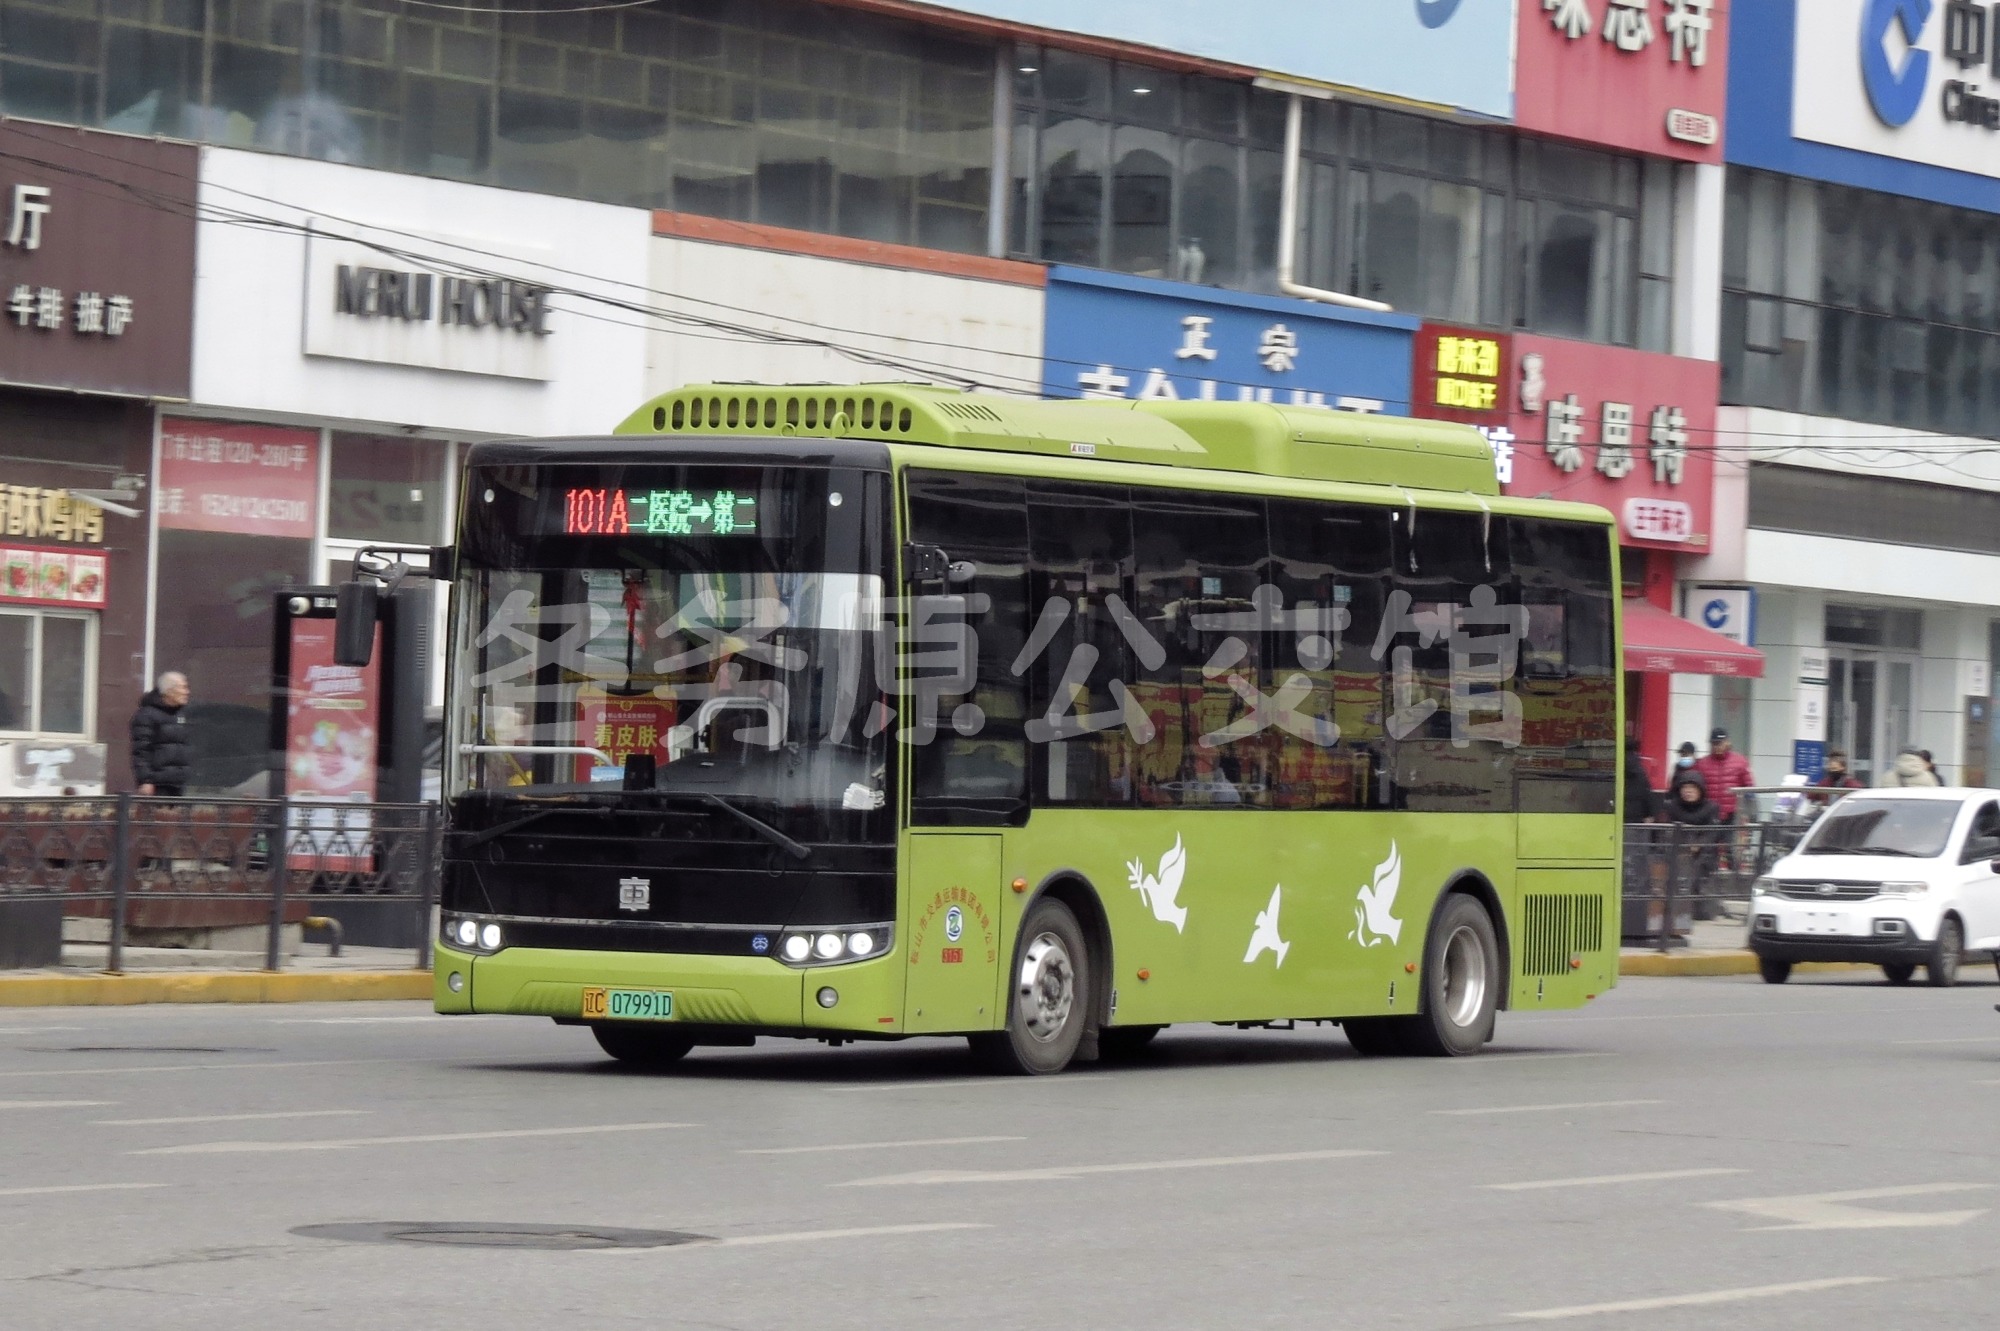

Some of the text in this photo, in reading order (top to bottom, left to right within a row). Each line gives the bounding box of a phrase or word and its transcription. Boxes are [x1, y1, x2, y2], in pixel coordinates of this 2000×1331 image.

[1944, 0, 2000, 80] 中
[8, 184, 52, 249] 厅
[8, 284, 134, 335] 牛排 披萨
[437, 276, 555, 338] HOUSE
[1174, 315, 1299, 372] 正宗
[1546, 393, 1690, 485] 味思特
[566, 489, 629, 534] 101A
[593, 723, 658, 749] 看皮肤
[584, 991, 673, 1017] 辽C 07991D
